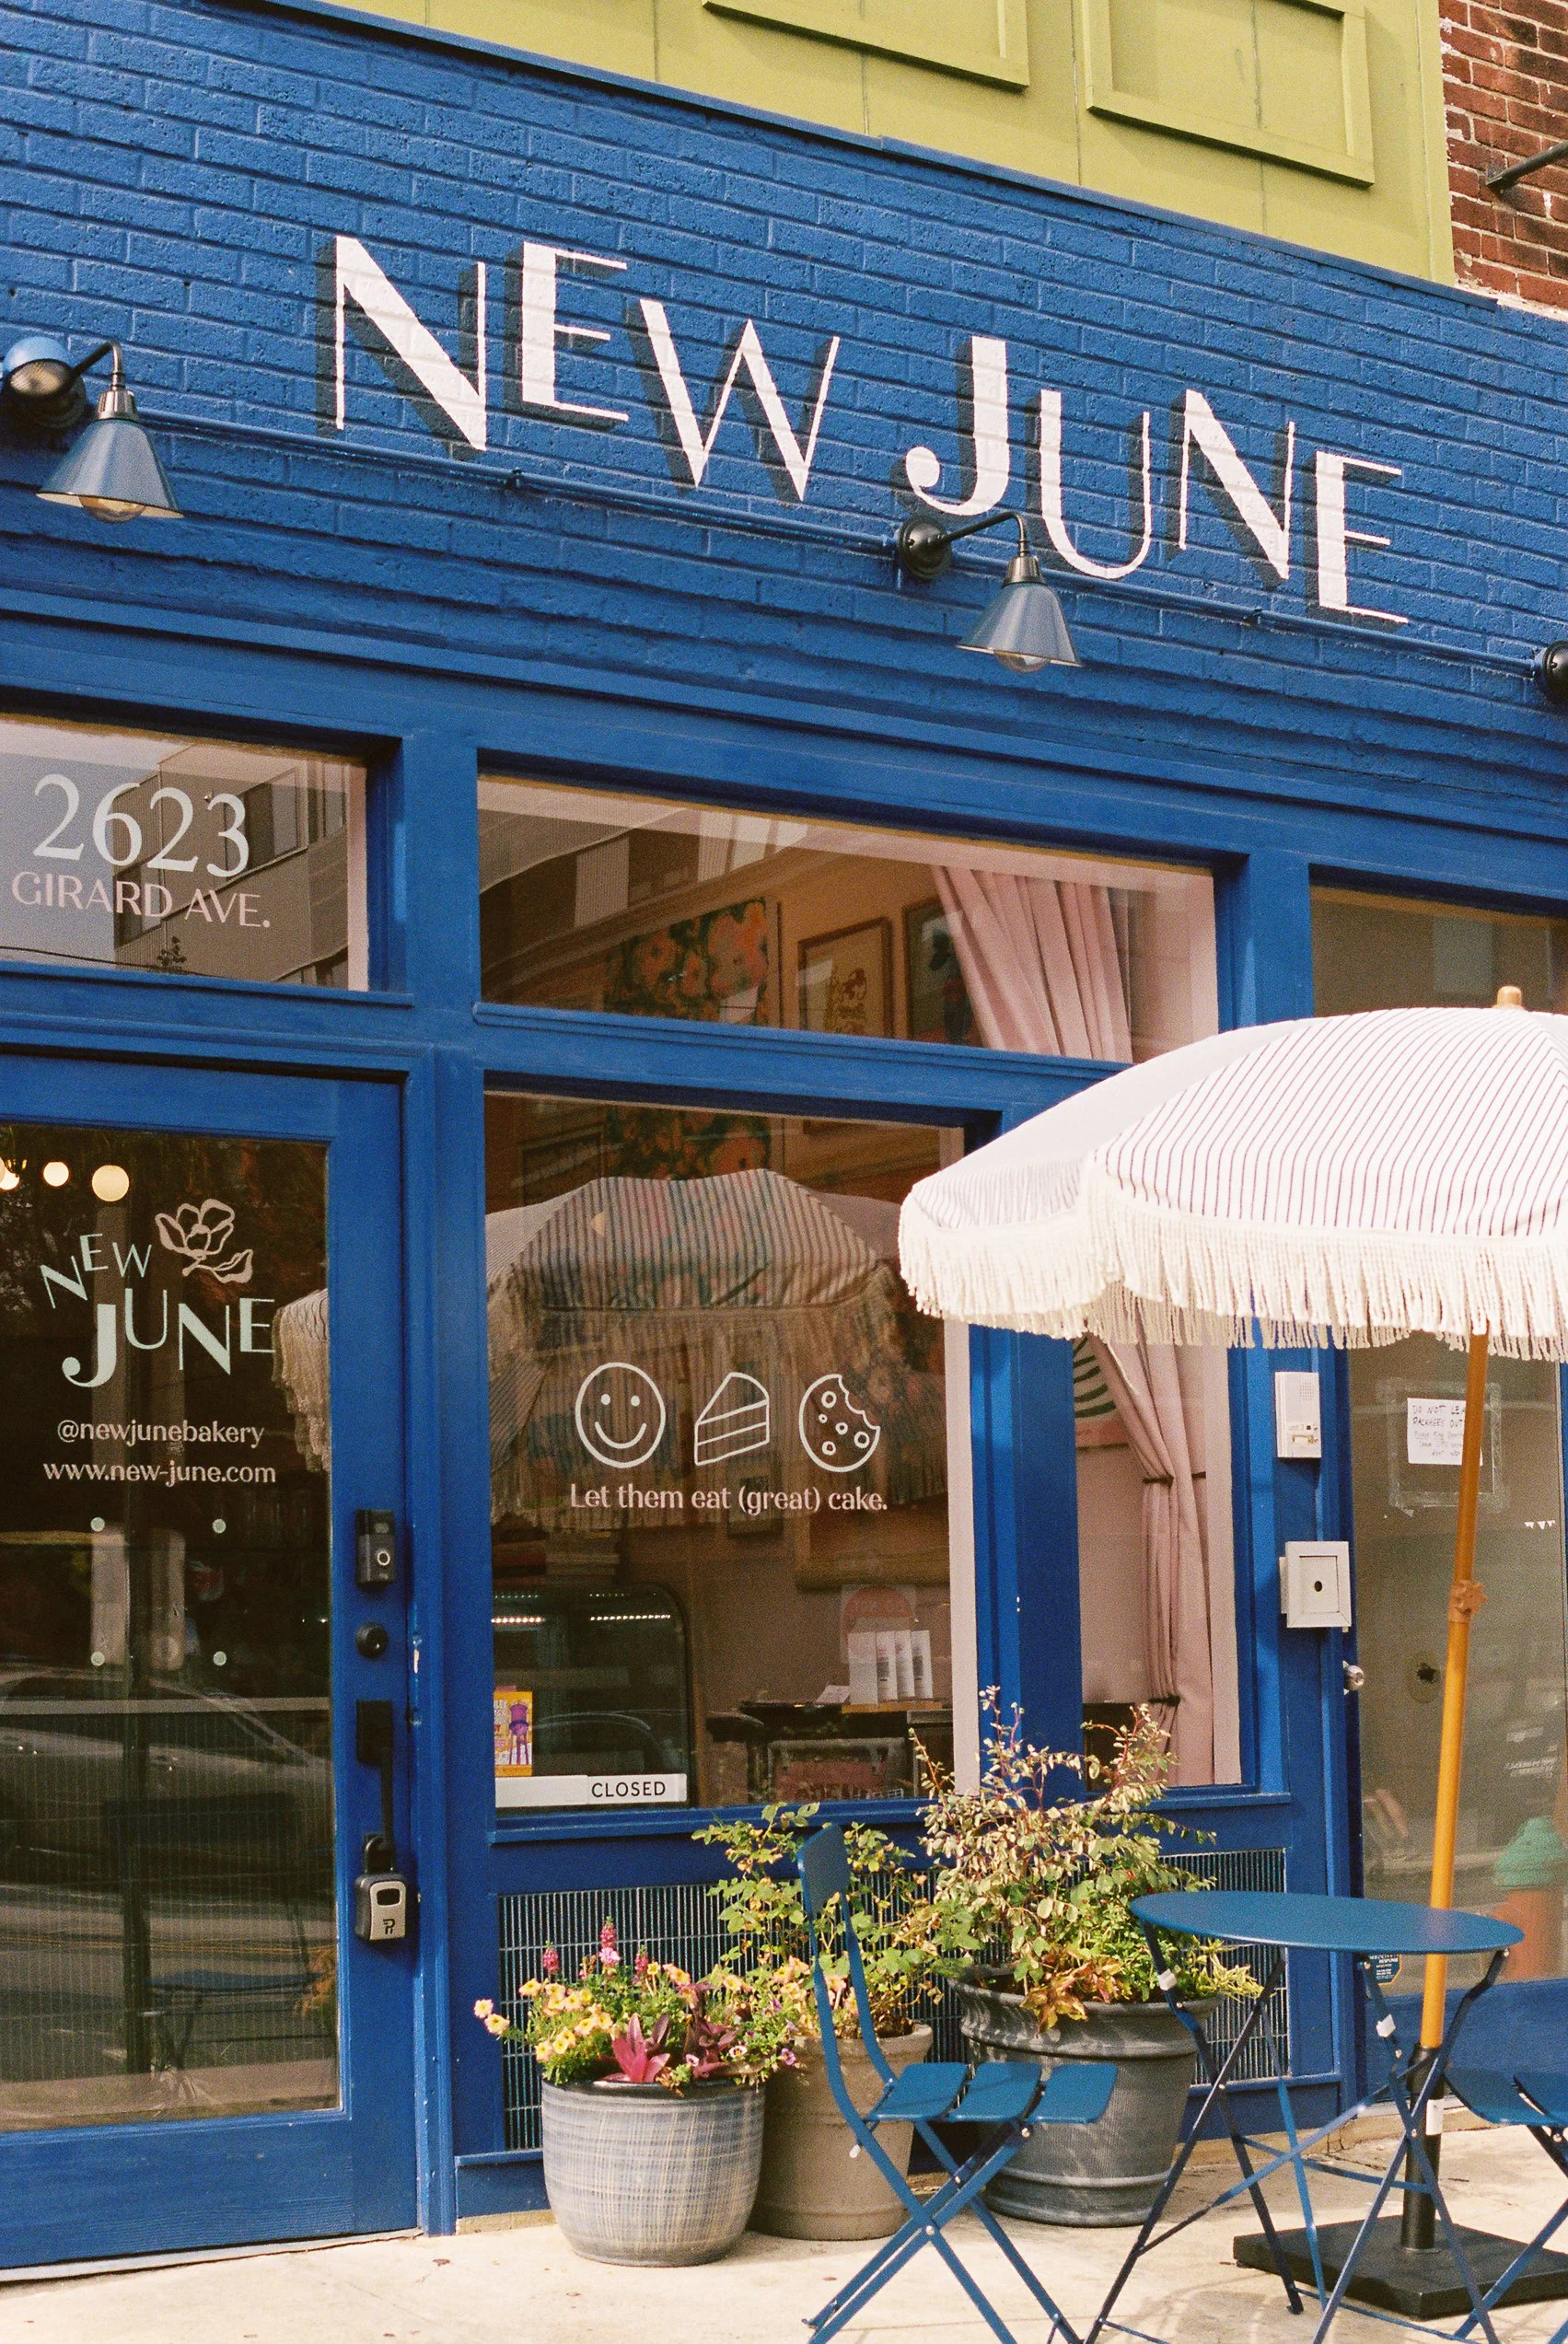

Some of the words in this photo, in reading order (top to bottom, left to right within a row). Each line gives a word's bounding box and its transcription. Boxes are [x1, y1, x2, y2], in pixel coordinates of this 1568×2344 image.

[333, 234, 841, 503] NEW
[905, 334, 1410, 625] JUNE
[33, 772, 250, 878] 2623
[11, 871, 174, 918] GIRARD
[183, 888, 271, 929] AVE.
[40, 1232, 153, 1309] NEW
[61, 1287, 276, 1388] JUNE
[56, 1418, 265, 1449] @newjunebakery
[42, 1459, 277, 1488] www.new-june.com
[570, 1483, 610, 1510] Let
[616, 1485, 684, 1510] them
[691, 1486, 732, 1510] eat
[738, 1485, 821, 1516] (great)
[828, 1486, 889, 1511] cake.
[591, 1781, 667, 1798] CLOSED
